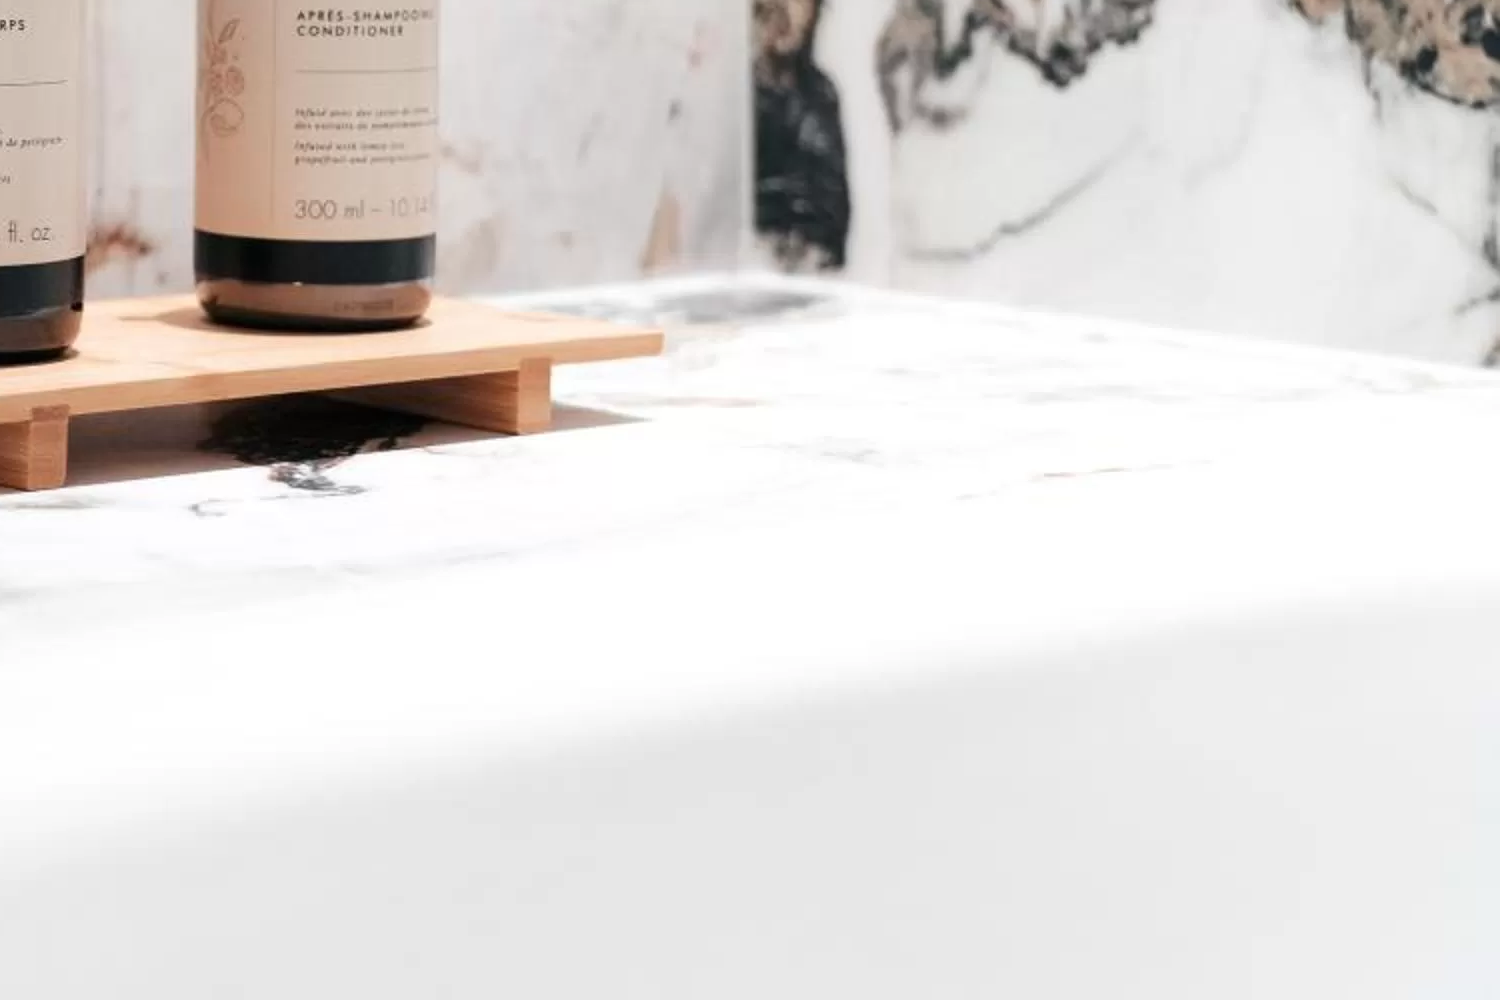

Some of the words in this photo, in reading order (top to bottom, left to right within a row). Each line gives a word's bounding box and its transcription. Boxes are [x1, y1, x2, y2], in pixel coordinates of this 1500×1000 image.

[296, 25, 404, 37] CONDITIONER
[294, 198, 338, 220] 300
[343, 198, 365, 219] ml
